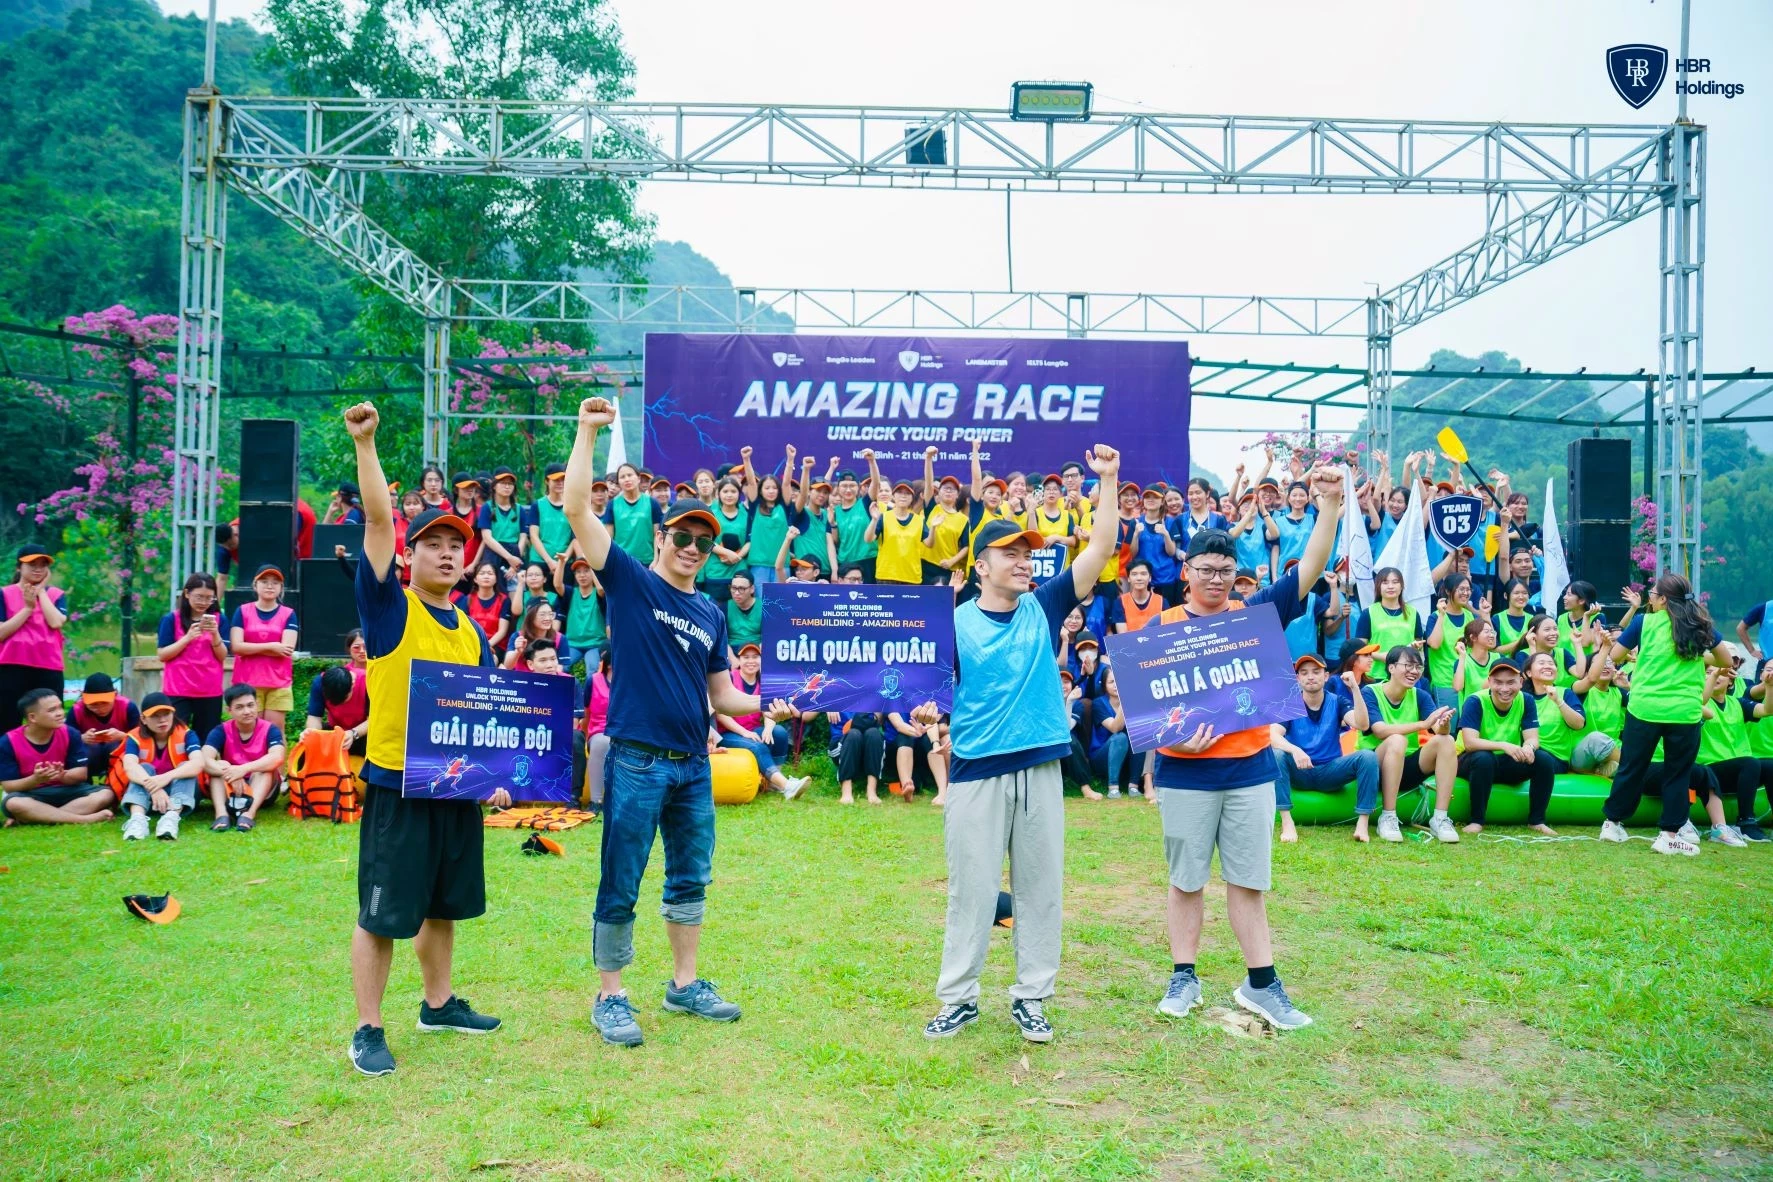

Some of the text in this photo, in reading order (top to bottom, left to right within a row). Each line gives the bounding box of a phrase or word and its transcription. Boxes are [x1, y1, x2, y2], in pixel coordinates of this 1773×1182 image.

[733, 380, 1105, 422] AMAZING RACE
[827, 426, 1014, 442] UNLOCK YOUR POWER
[939, 452, 946, 460] 11
[969, 452, 991, 460] 222
[1442, 504, 1471, 513] TEAM
[1443, 516, 1470, 534] 03
[791, 618, 854, 627] TEAMBUILDING
[862, 619, 901, 627] AMAZING
[902, 620, 925, 628] RACE
[1165, 637, 1229, 655] UNLOCK YOUR POWER
[1187, 633, 1217, 644] HOLDINGS
[776, 633, 936, 665] GIẢI QUÁN QUÂN
[1138, 651, 1196, 669] TEAMBUILDING
[1203, 643, 1238, 656] AMAZING
[1238, 638, 1261, 649] RACE
[1150, 657, 1261, 700] GIẢI Á QUÂN
[476, 686, 517, 696] HBR HOLDINGS
[436, 699, 493, 711] TEAMBUILDING
[500, 706, 532, 714] AMAZING
[533, 707, 552, 716] RACE
[507, 696, 526, 704] POWER
[430, 715, 553, 757] GIẢI ĐỒNG ĐỘI
